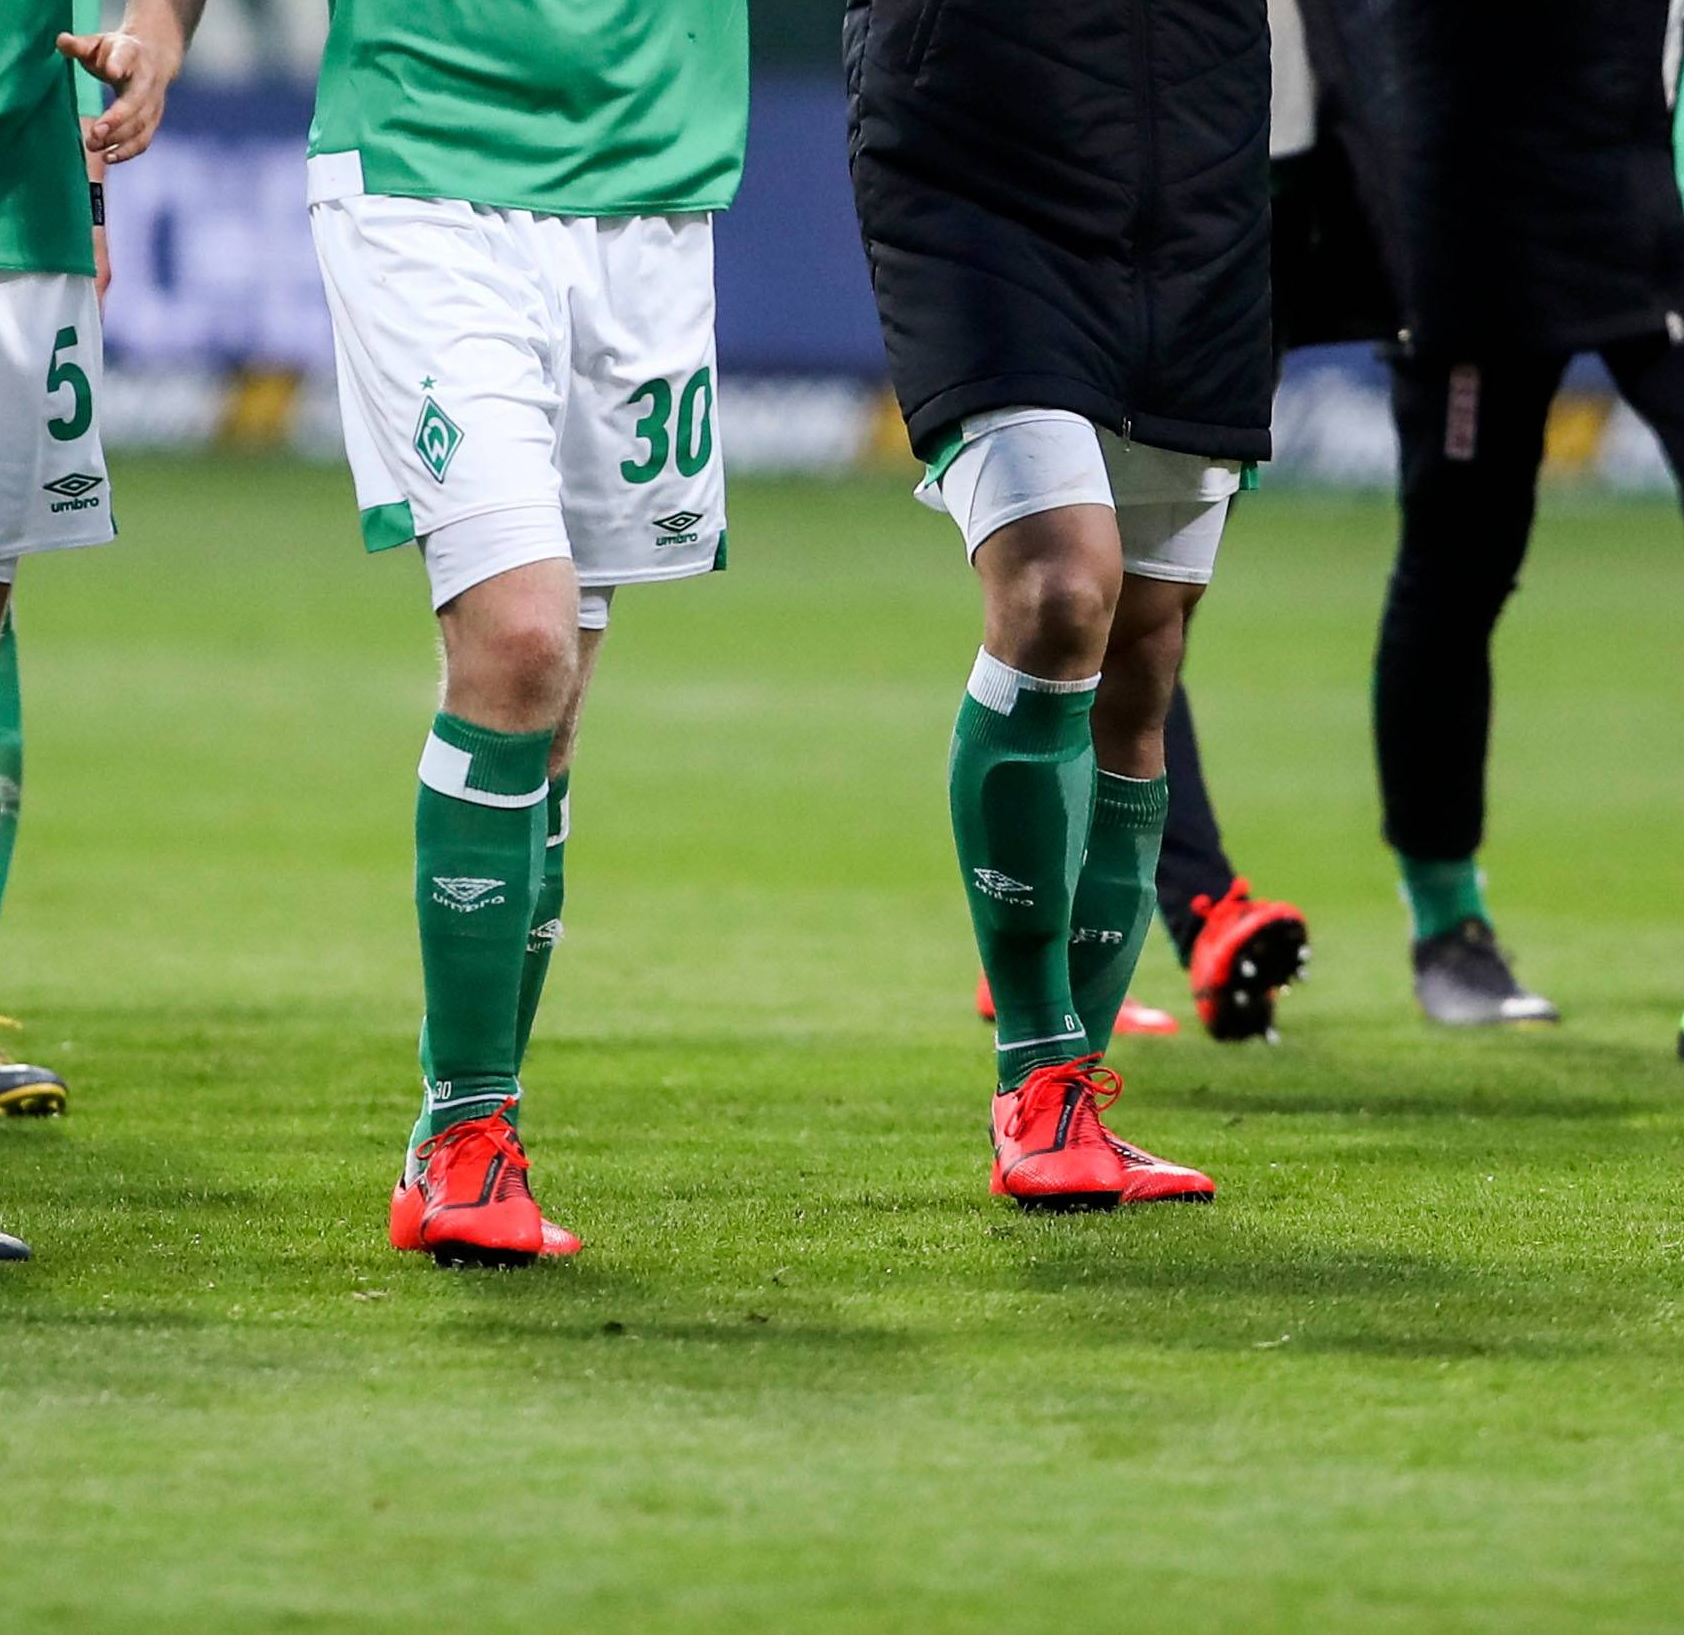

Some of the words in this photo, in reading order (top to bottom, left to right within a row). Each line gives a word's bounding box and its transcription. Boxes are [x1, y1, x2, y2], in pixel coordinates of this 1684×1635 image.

[46, 325, 93, 442] 5
[619, 366, 713, 485] 30
[51, 495, 100, 513] umbro
[655, 531, 699, 547] umbro
[432, 891, 506, 914] umbro
[434, 1080, 453, 1100] 30
